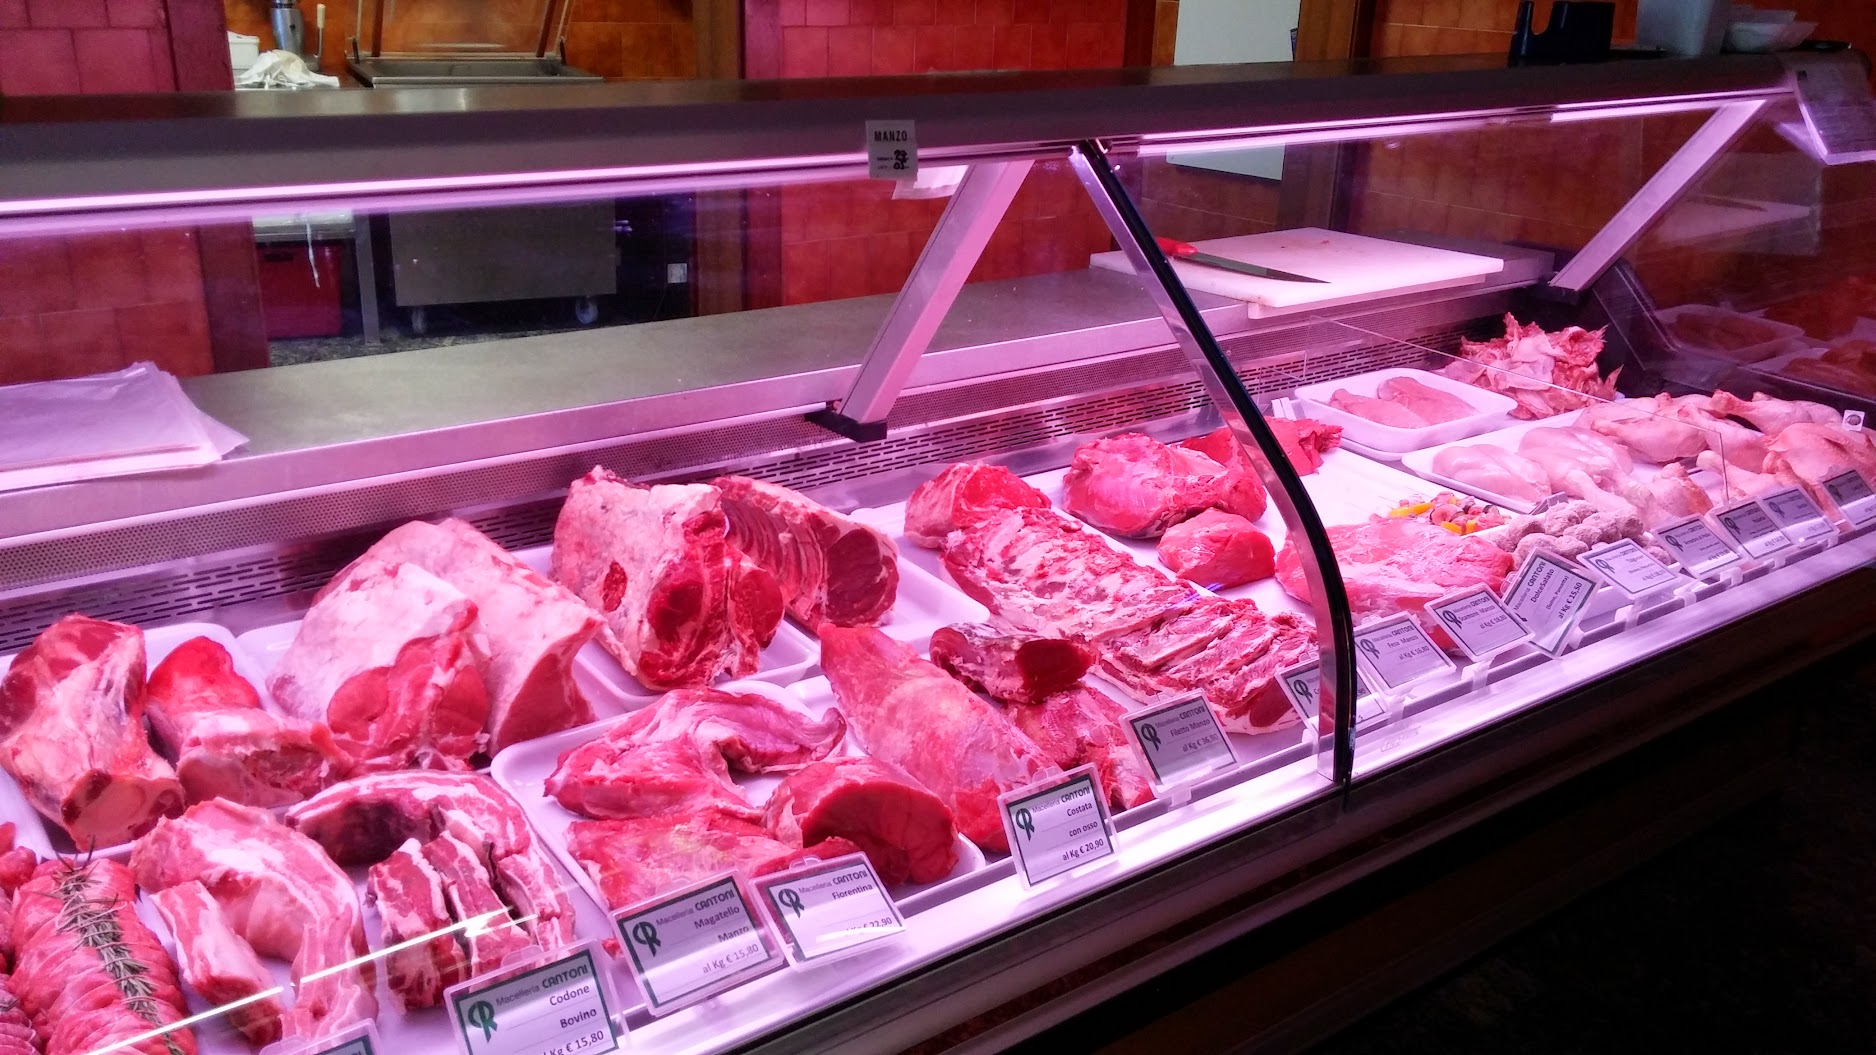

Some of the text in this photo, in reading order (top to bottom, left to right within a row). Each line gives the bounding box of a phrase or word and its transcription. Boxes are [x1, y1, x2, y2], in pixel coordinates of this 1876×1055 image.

[874, 130, 907, 141] MANZO
[1527, 561, 1547, 587] CANTONI
[1530, 568, 1555, 603] DolceSalato
[1561, 603, 1571, 613] Kg
[1569, 582, 1583, 600] 15,50
[1180, 705, 1206, 720] CANTONI
[1170, 719, 1211, 737] Filetto Manzo
[1188, 741, 1198, 750] Kg
[1060, 786, 1091, 803] CANTONI
[1066, 802, 1093, 817] Costata
[1069, 821, 1098, 837] con osso
[1062, 838, 1104, 861] al Kg € 20,90
[832, 870, 868, 886] CANTONI
[694, 889, 735, 911] CANTONI
[832, 883, 873, 900] Fiorentina
[694, 906, 740, 929] Magatello
[717, 925, 750, 943] Manzo
[703, 943, 759, 974] al Kg € 15,80
[495, 964, 588, 1006] Macelleria CANTONI
[549, 985, 590, 1006] Codone
[559, 1008, 597, 1028] Bovino
[566, 1042, 573, 1053] €
[575, 1030, 604, 1050] 15,80
